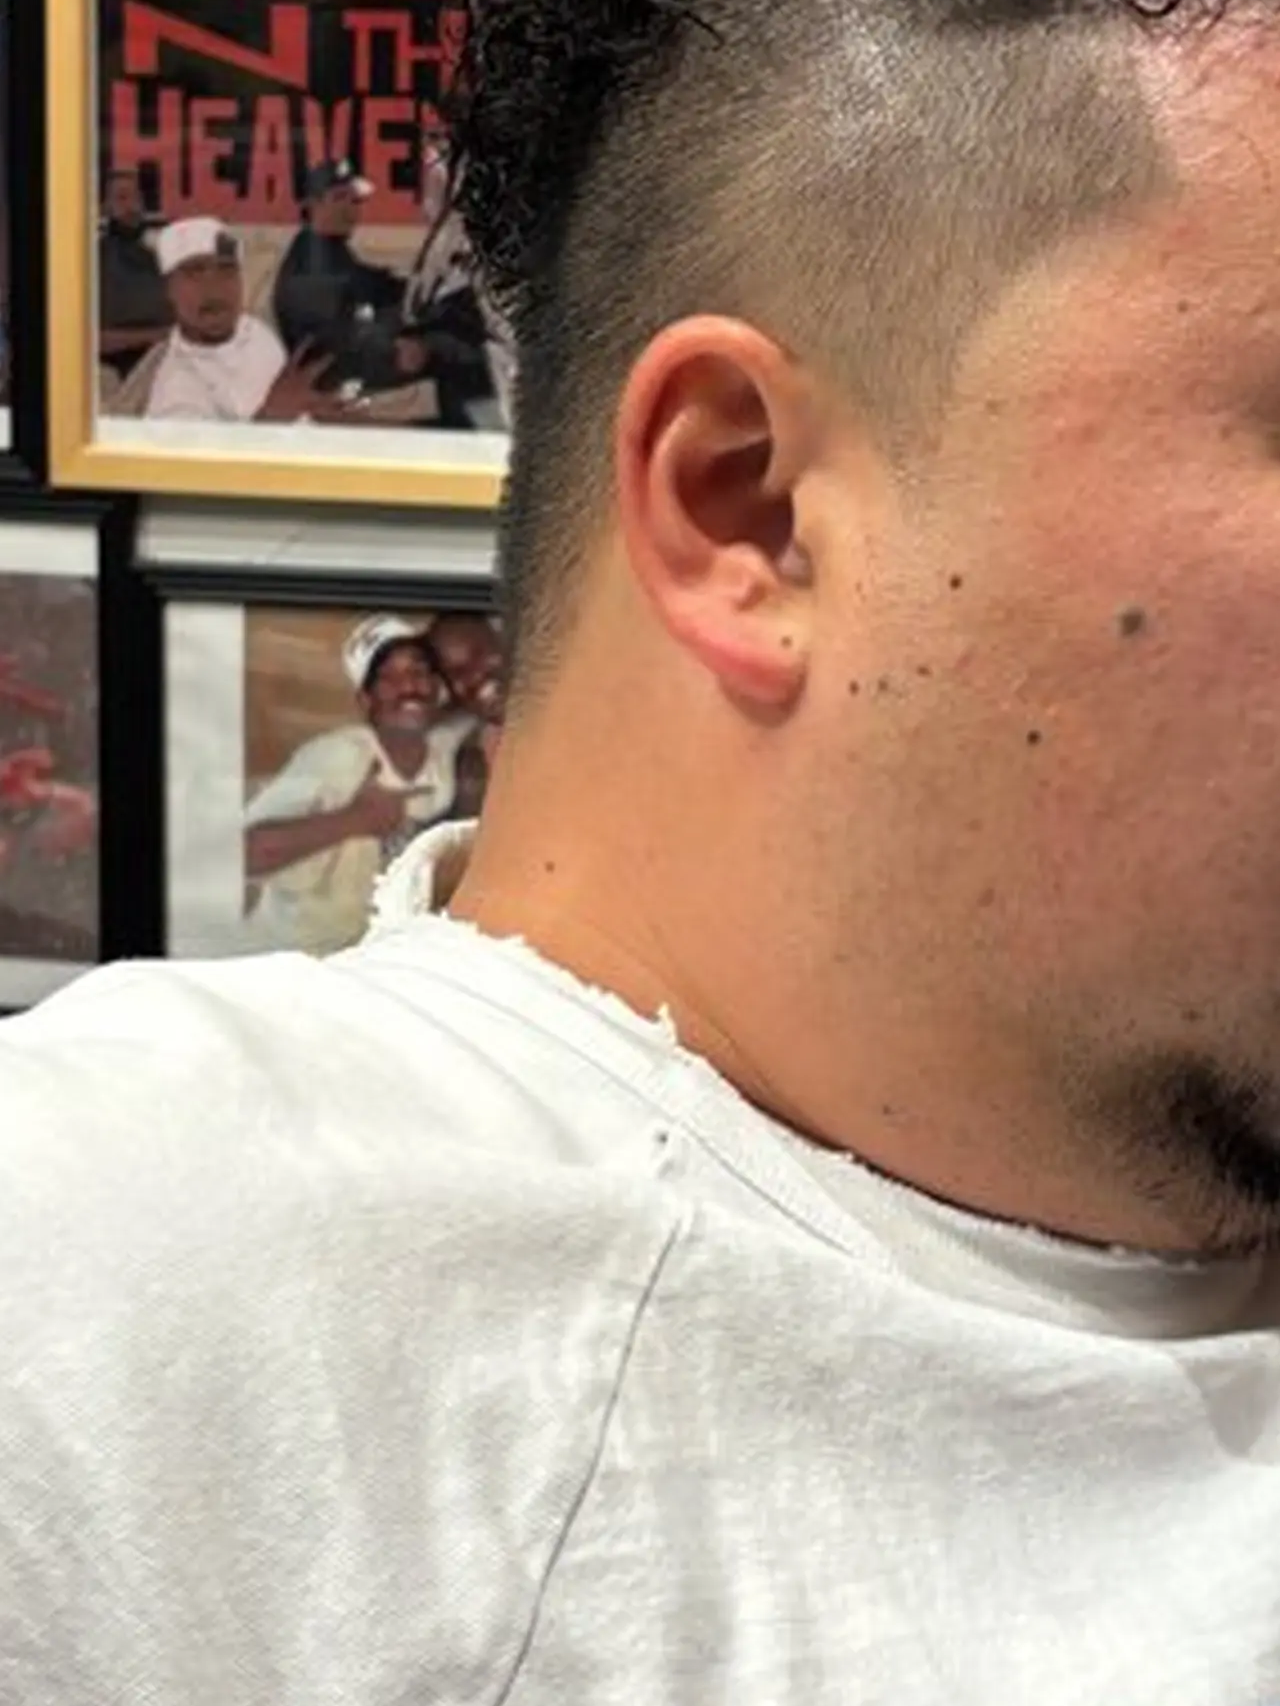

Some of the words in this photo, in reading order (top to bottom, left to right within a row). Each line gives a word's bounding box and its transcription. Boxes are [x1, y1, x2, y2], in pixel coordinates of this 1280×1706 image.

[123, 1, 311, 90] N
[342, 7, 470, 94] TH
[108, 79, 452, 227] HEAVE
